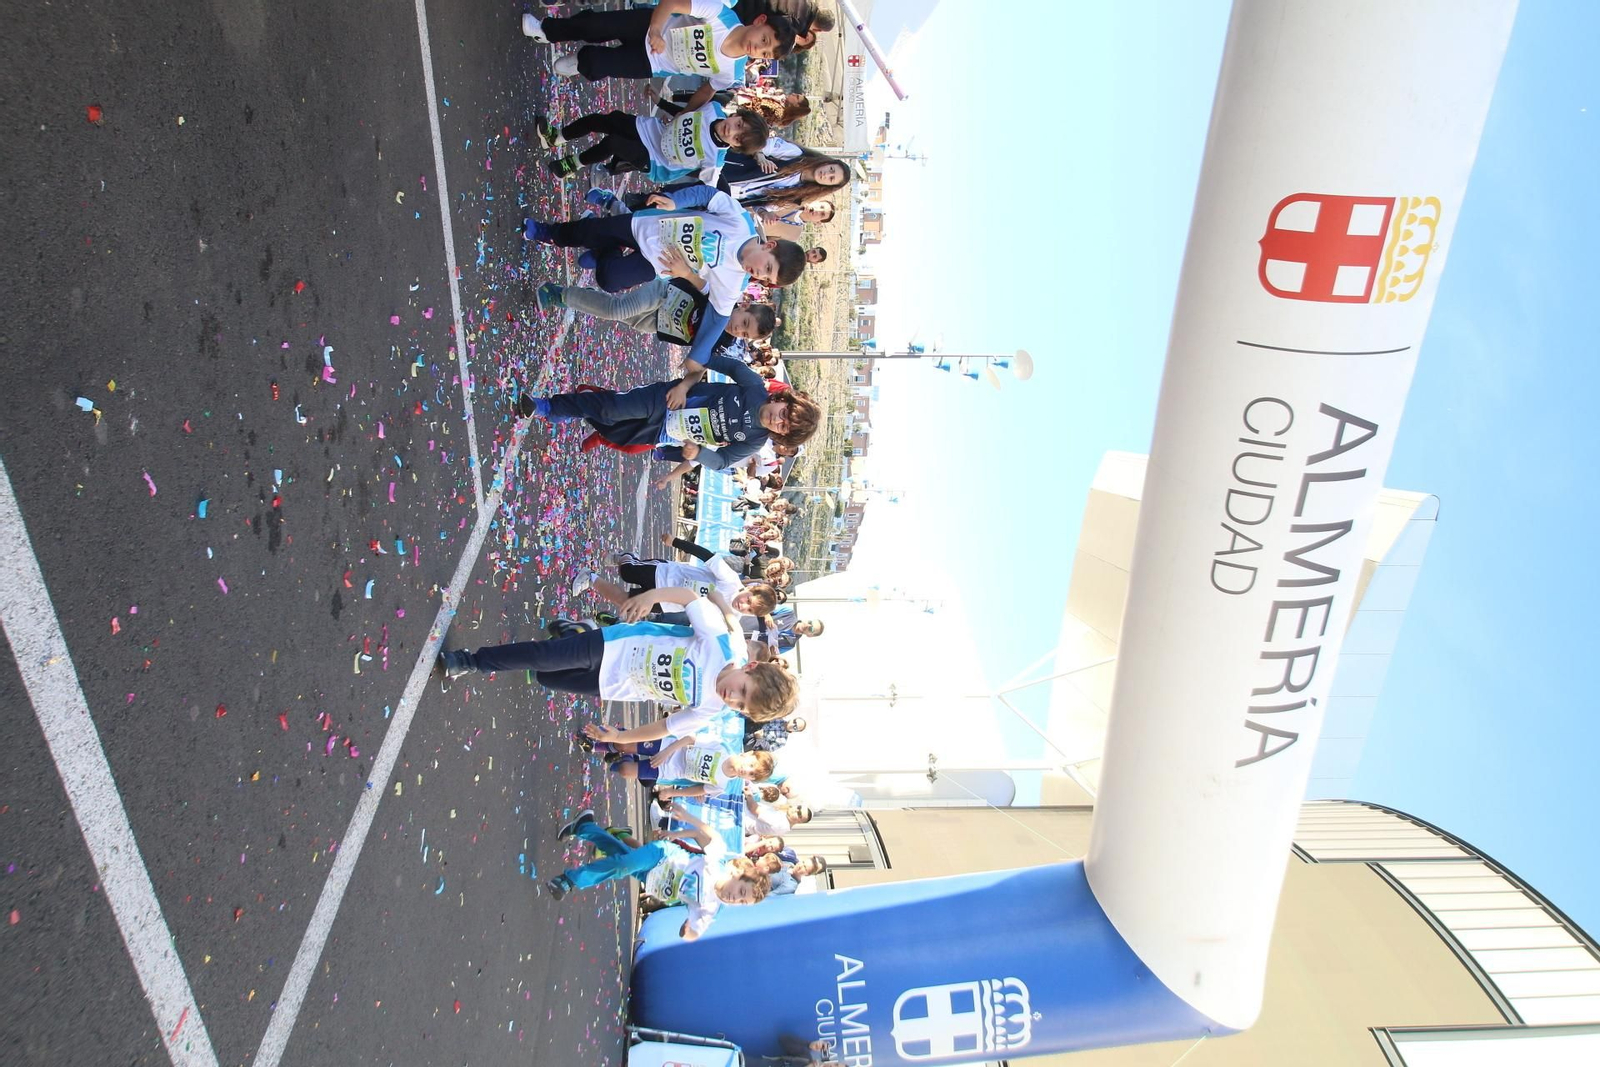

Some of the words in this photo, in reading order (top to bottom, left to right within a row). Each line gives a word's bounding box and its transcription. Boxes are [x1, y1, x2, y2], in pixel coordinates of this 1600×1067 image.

[694, 29, 710, 69] 8401
[855, 78, 866, 128] ALMERÍA
[682, 118, 696, 157] 8430
[681, 224, 698, 263] 8003
[674, 299, 688, 335] 8067
[1210, 396, 1295, 596] CIUDAD
[1234, 402, 1379, 769] ALMERÍA
[657, 654, 678, 701] 8197
